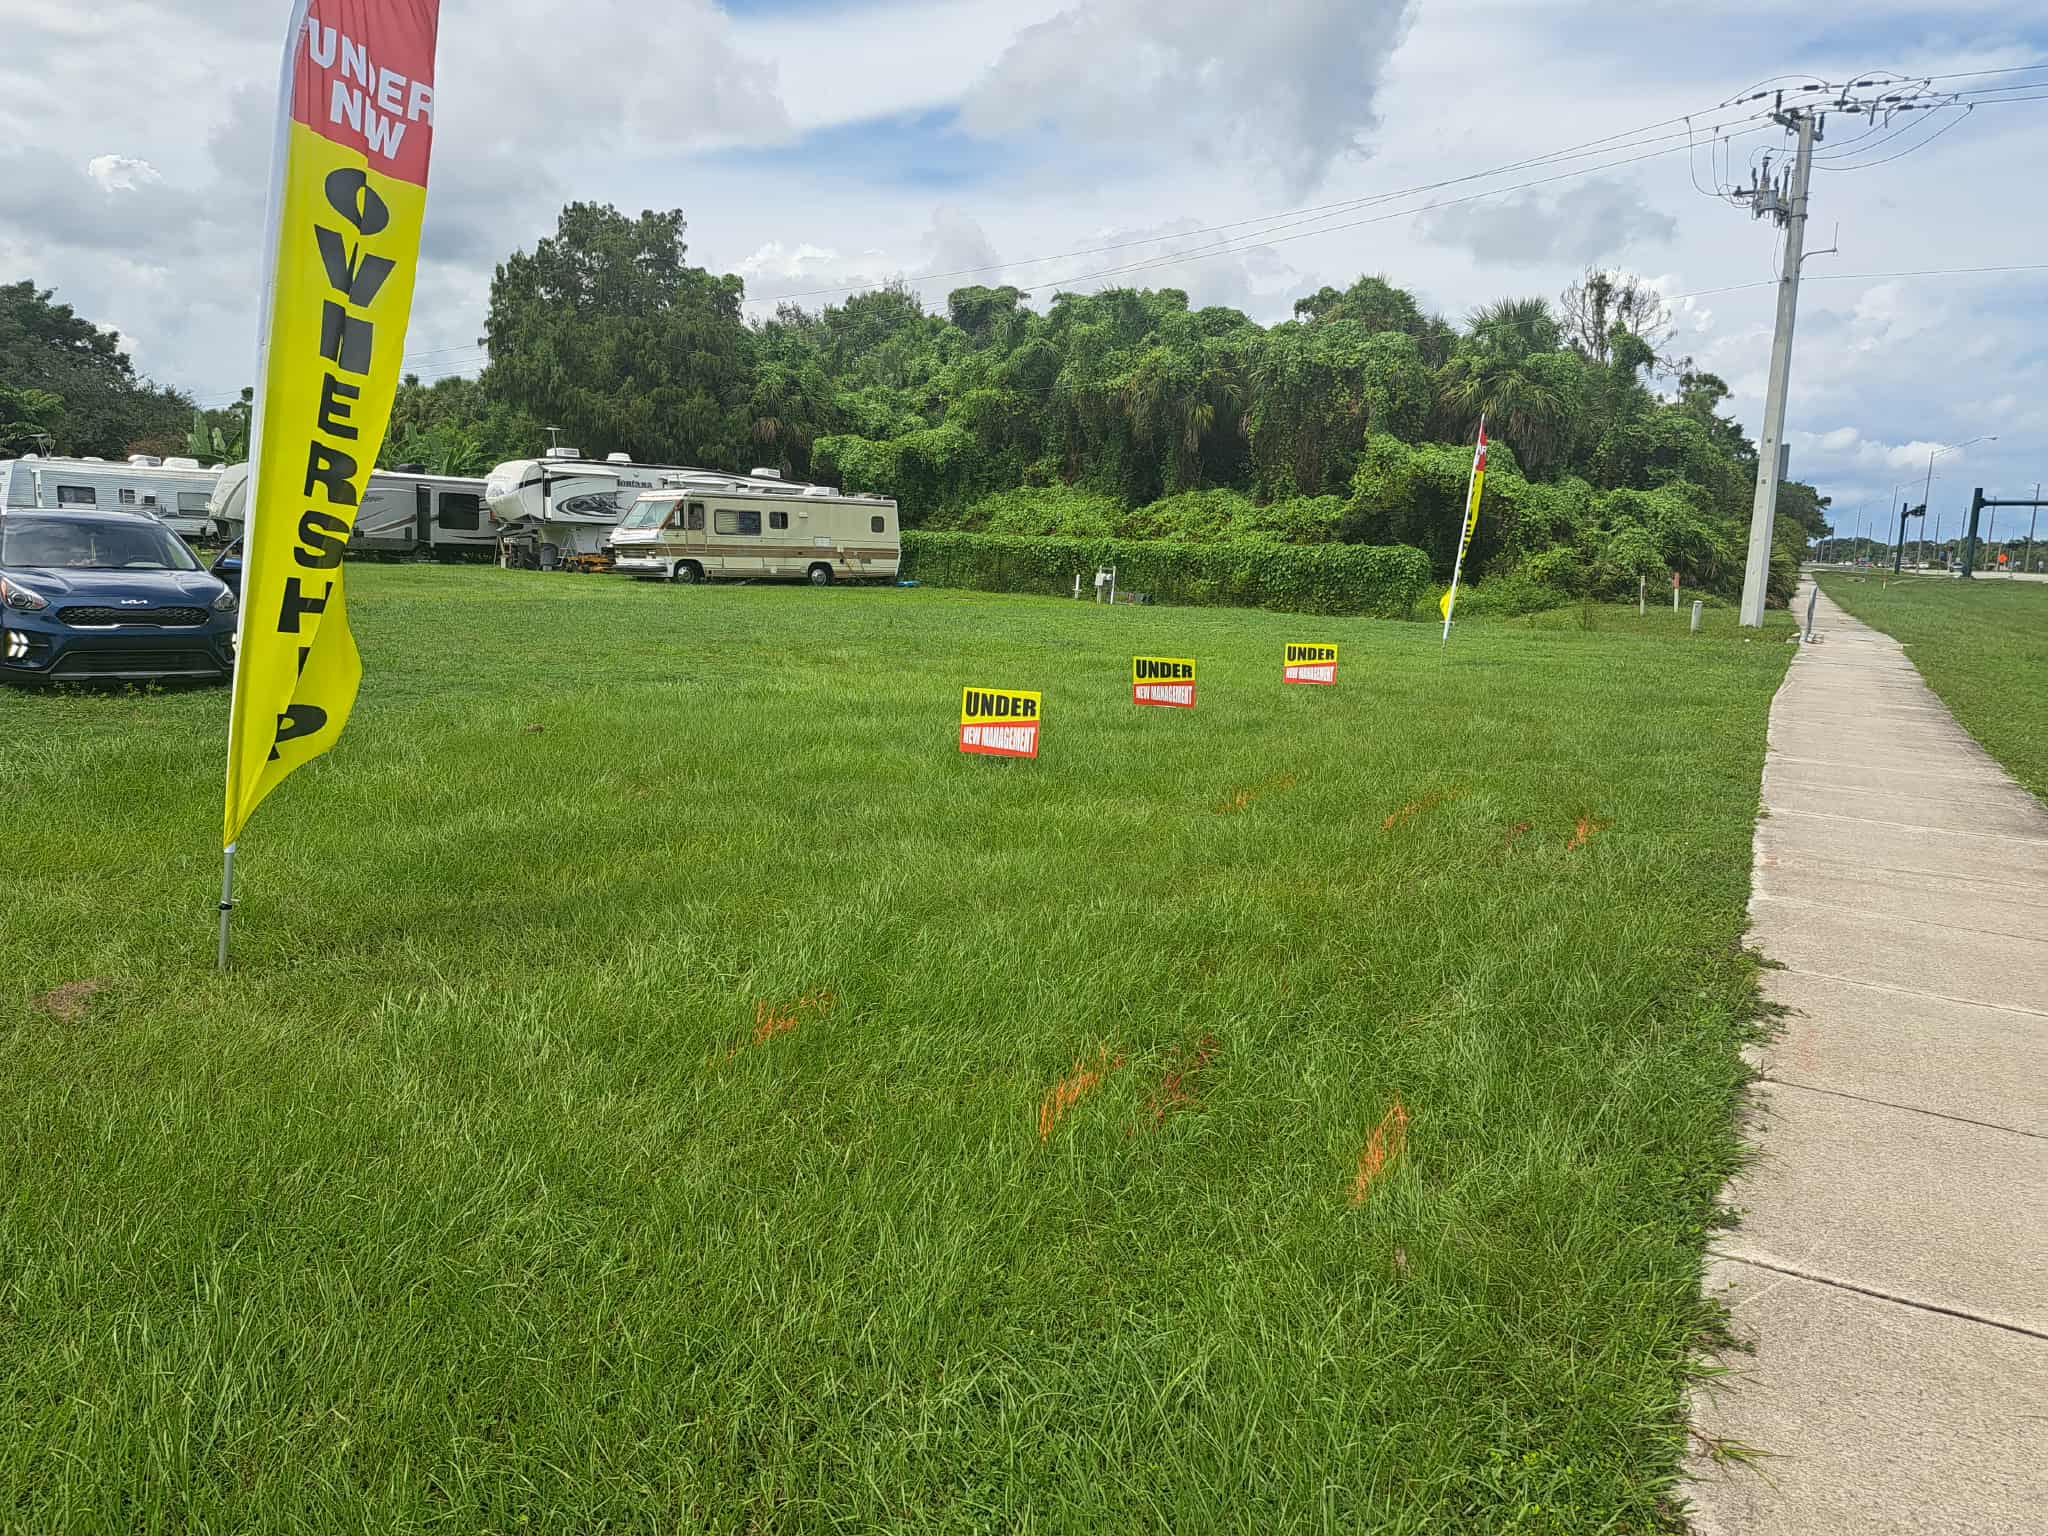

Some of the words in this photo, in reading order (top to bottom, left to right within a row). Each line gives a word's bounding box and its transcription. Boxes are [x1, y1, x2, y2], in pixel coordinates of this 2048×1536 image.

[308, 17, 433, 127] UNER
[1287, 646, 1335, 661] UNDER
[1136, 659, 1193, 678] UNDER
[965, 690, 1037, 717] UNDER
[963, 726, 981, 746] NEW
[981, 726, 1035, 753] MANAGEMENT
